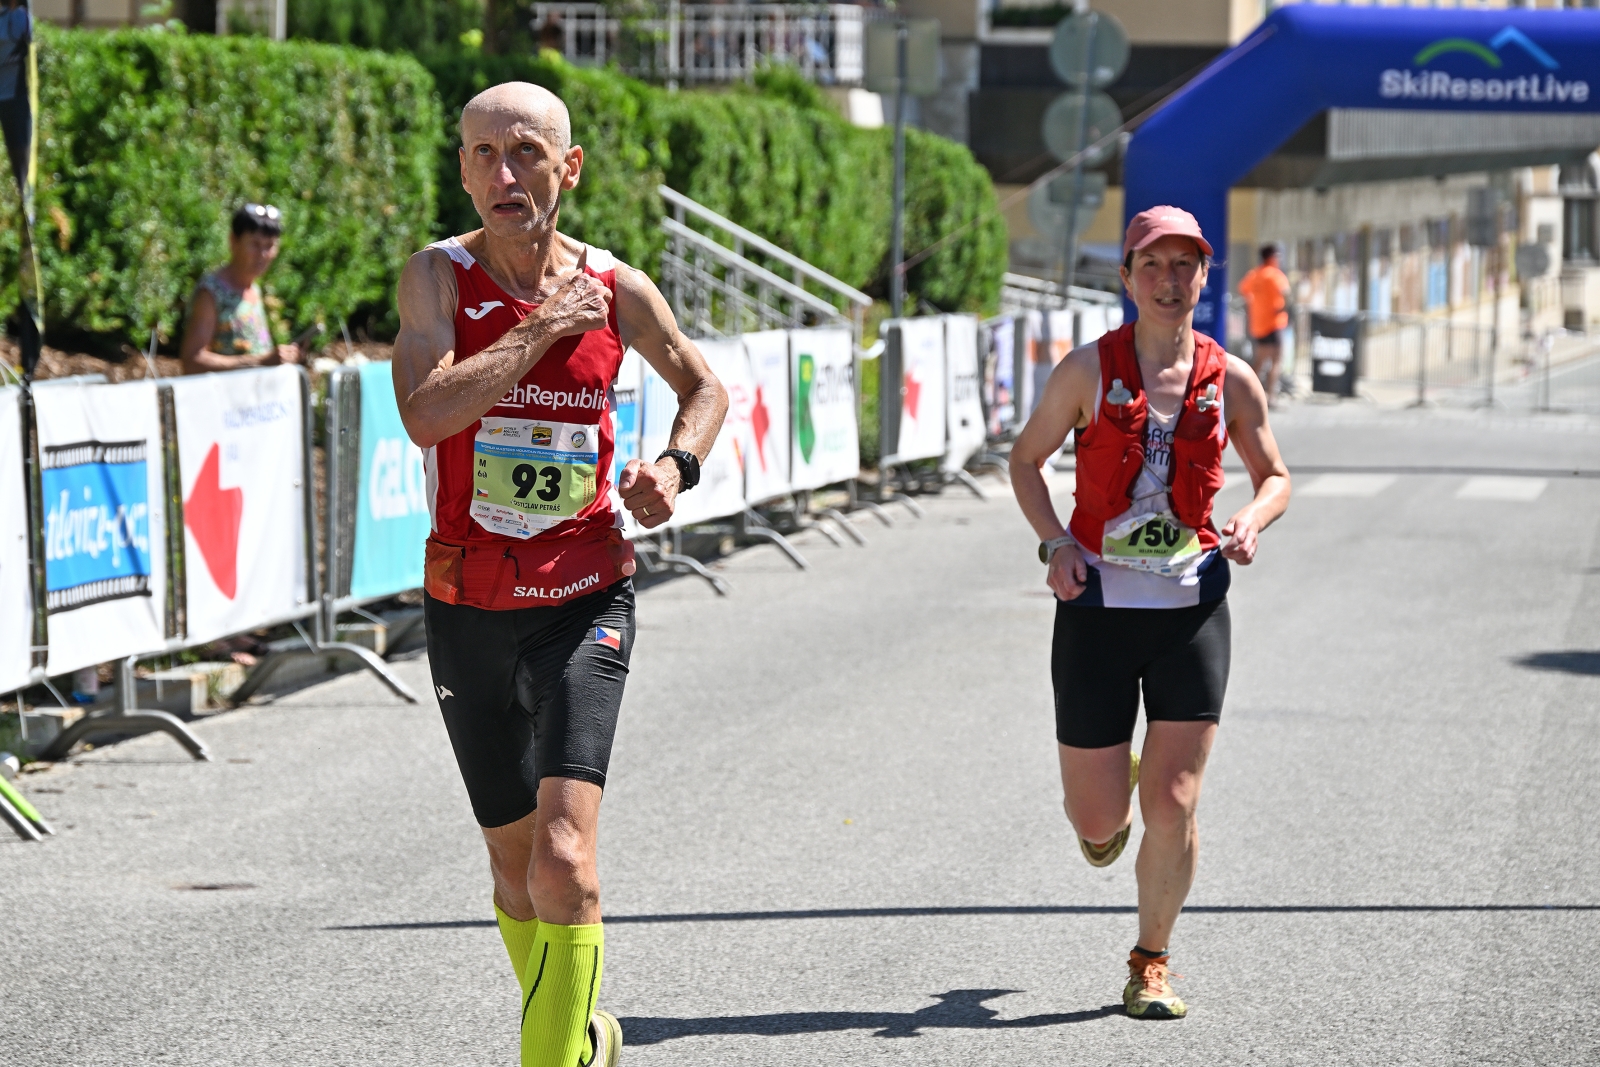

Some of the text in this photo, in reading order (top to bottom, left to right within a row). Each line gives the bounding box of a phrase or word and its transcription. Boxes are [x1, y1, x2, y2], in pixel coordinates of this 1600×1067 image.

[1379, 69, 1590, 102] SkiResortLive
[500, 382, 609, 411] chRepublic
[478, 458, 487, 468] M
[511, 463, 562, 502] 93
[539, 502, 561, 512] PETRÁŠ
[512, 572, 600, 599] SALOMON
